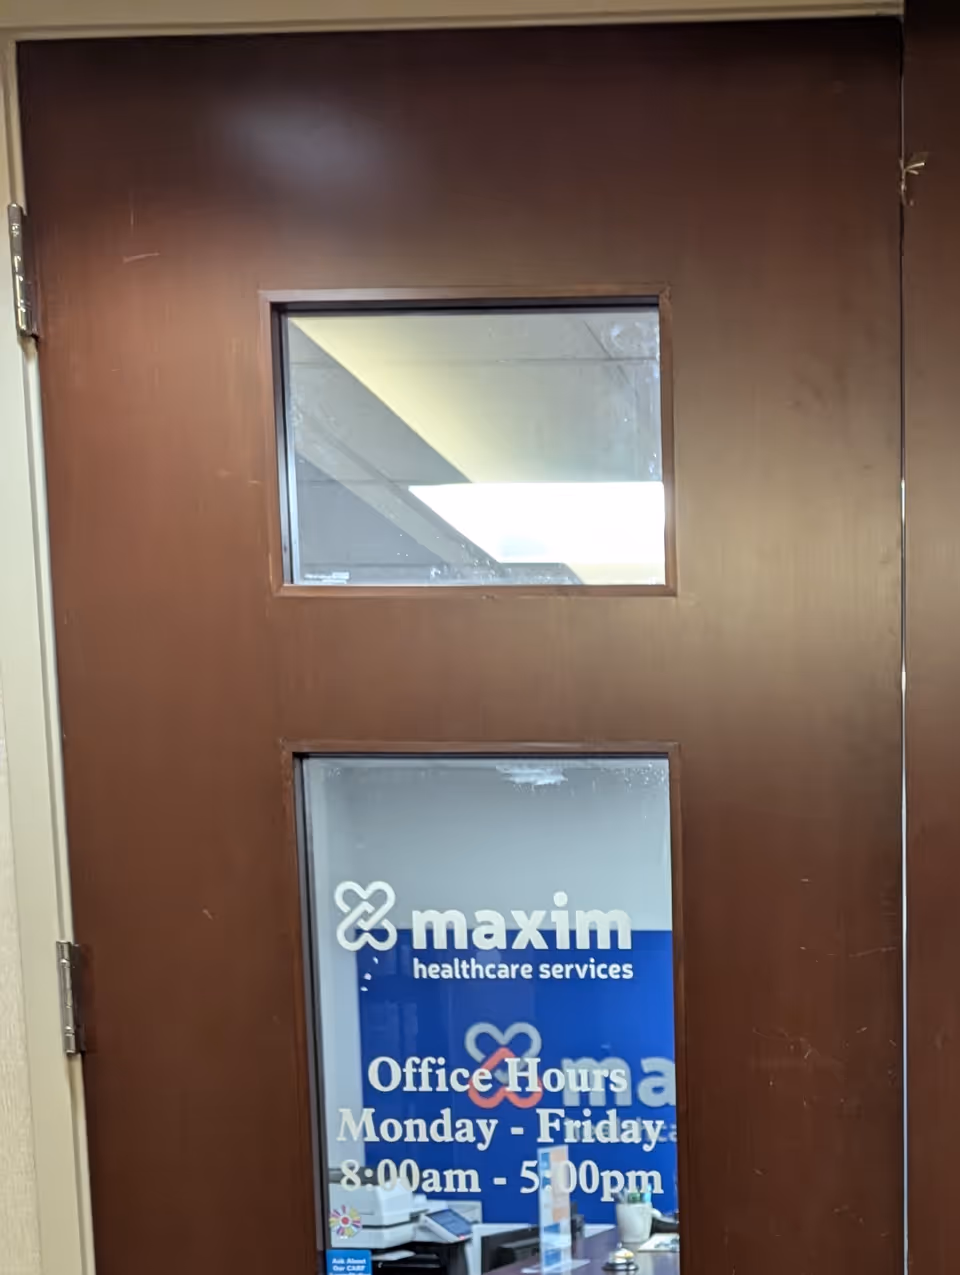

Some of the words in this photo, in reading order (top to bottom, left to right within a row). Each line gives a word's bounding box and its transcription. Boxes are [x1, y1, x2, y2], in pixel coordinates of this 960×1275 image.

[412, 891, 632, 950] maxim
[413, 958, 533, 980] healthcare
[539, 958, 634, 980] services
[368, 1056, 493, 1092] Office
[504, 1057, 628, 1093] Hours
[336, 1108, 498, 1151] Monday
[536, 1108, 664, 1152] Friday
[340, 1158, 481, 1193] 8:00am
[520, 1160, 664, 1202] 5:00pm
